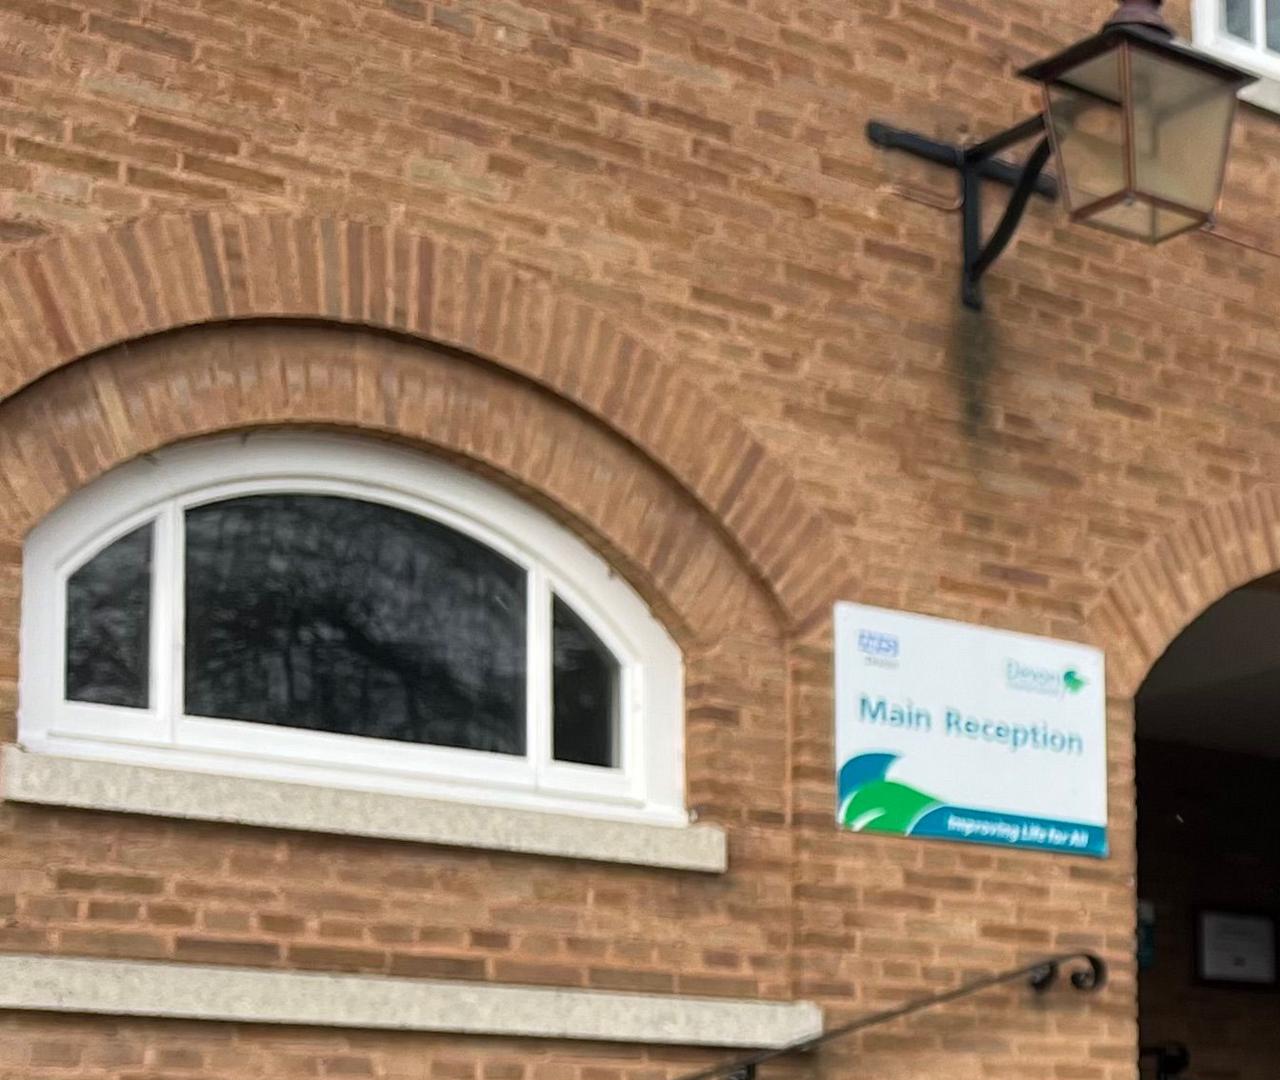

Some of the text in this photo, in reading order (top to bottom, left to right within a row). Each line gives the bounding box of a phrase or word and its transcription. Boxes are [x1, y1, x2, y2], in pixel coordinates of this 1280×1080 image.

[859, 697, 1083, 755] Main Reception
[948, 814, 1089, 848] Improving Life for All
